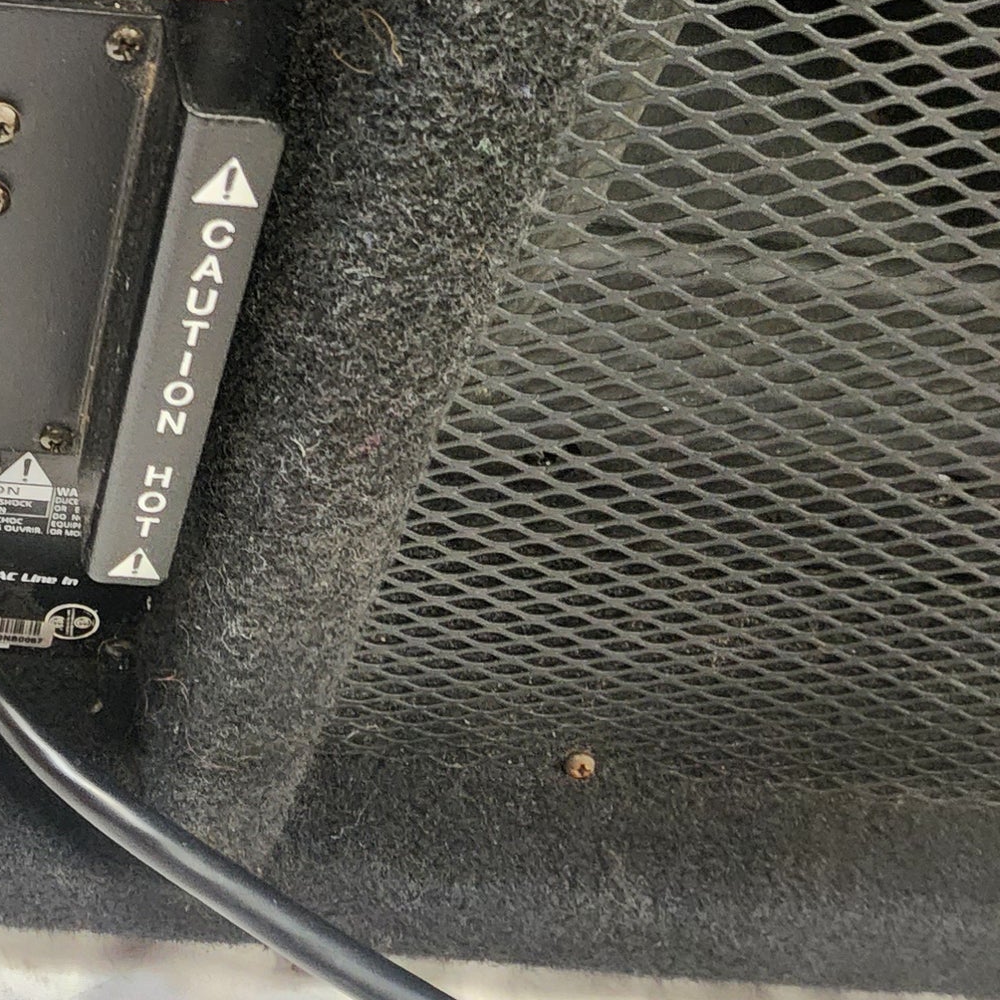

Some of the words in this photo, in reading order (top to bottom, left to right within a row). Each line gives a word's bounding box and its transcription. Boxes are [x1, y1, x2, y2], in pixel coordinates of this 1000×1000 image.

[157, 218, 236, 436] CAUTION
[0, 498, 33, 508] SHOCK
[135, 465, 174, 538] HOT
[20, 572, 58, 585] Line
